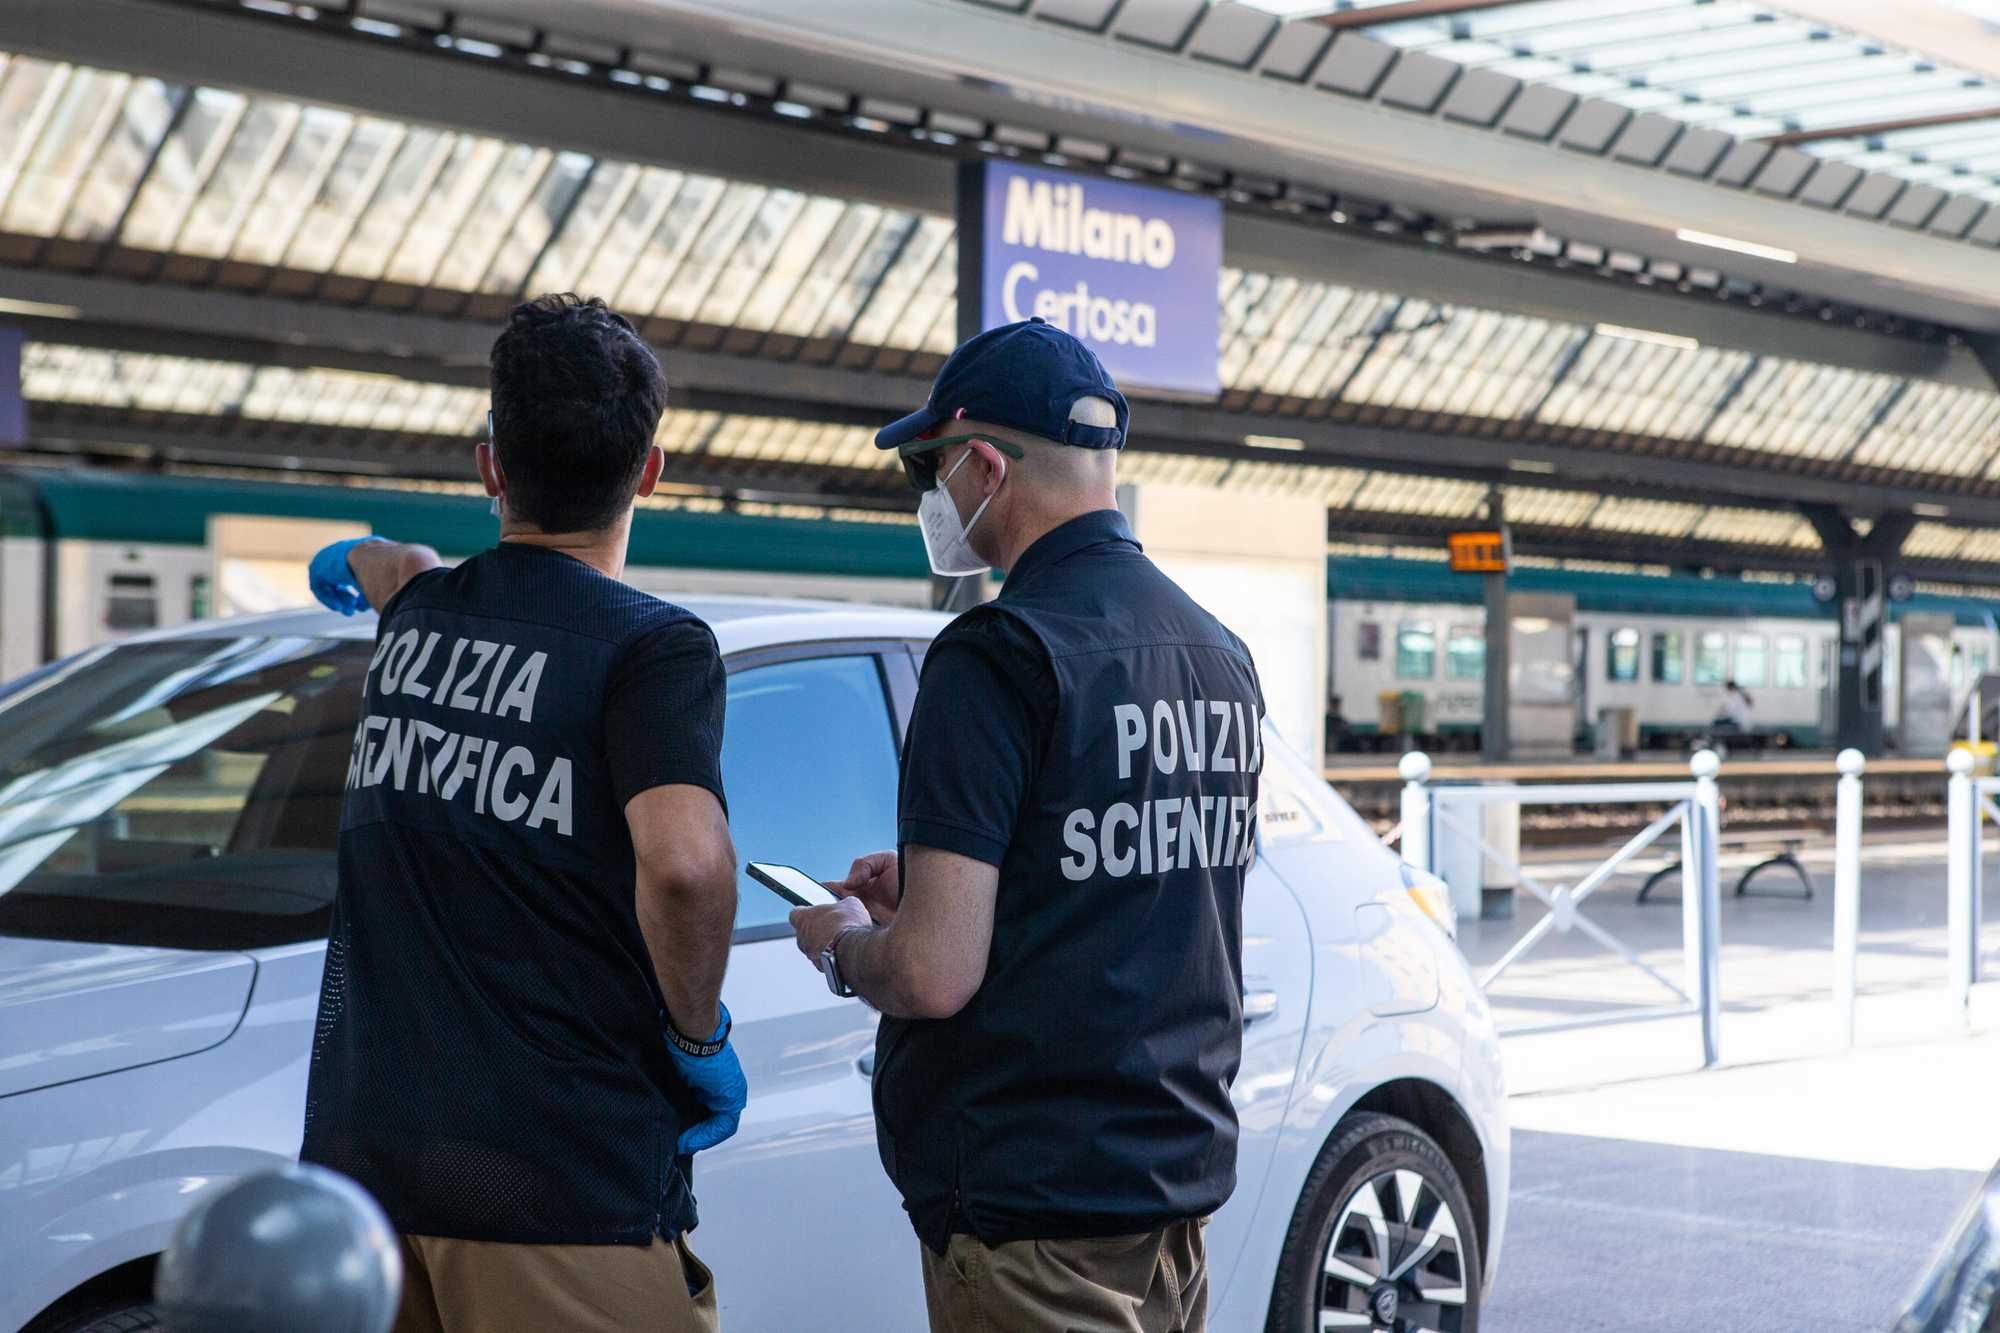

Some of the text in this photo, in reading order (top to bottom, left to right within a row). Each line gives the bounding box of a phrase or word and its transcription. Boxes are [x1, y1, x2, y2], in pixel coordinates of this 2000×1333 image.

[1003, 176, 1175, 269] Milano
[1003, 261, 1156, 347] Certosa
[362, 627, 548, 723] POLIZIA
